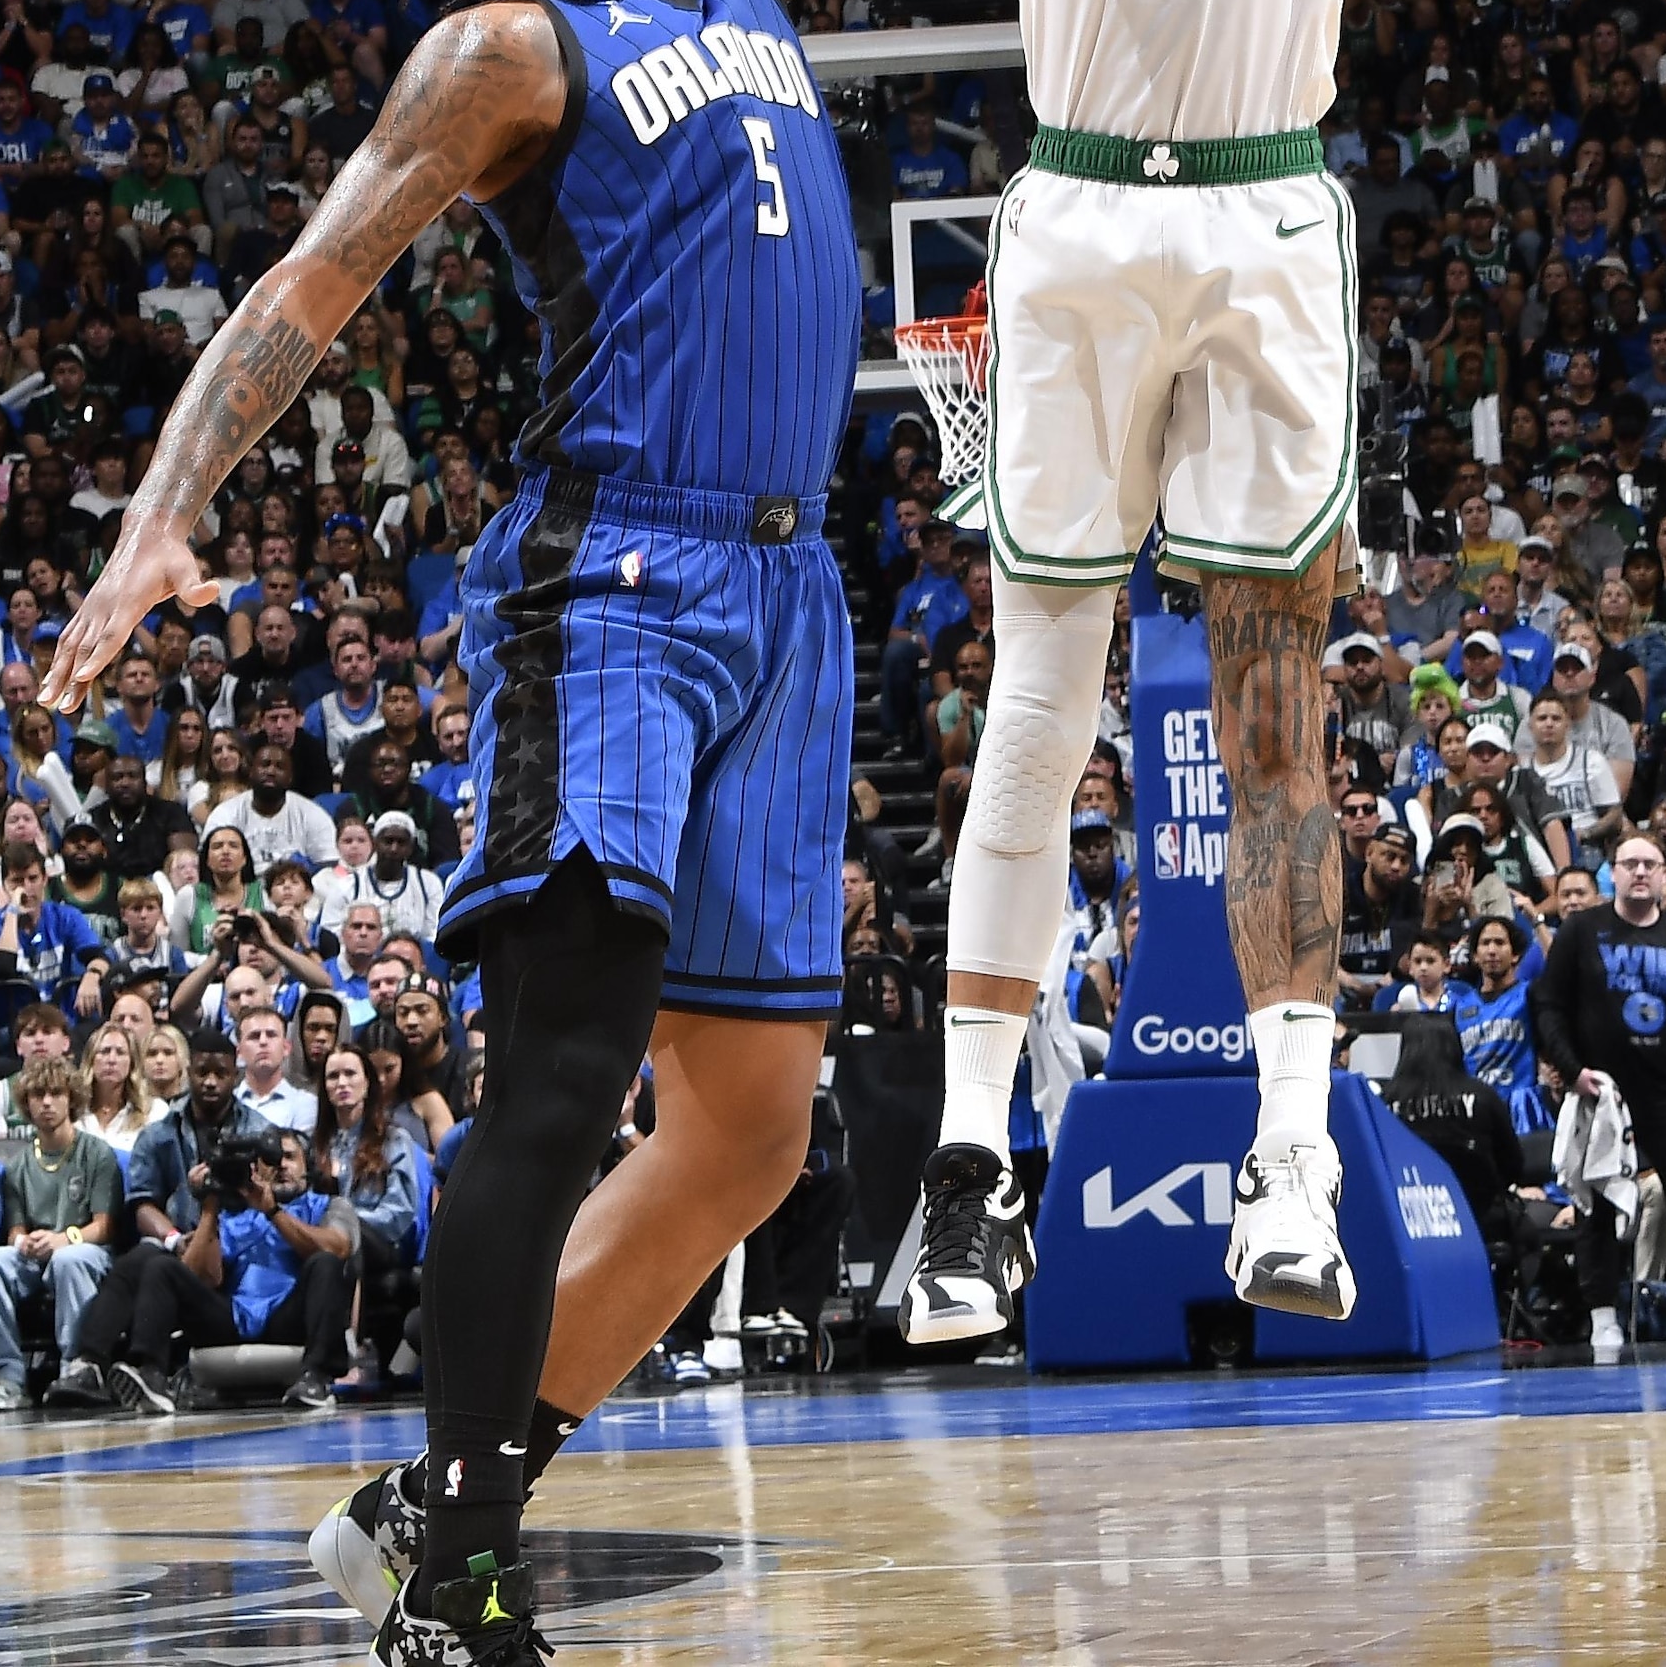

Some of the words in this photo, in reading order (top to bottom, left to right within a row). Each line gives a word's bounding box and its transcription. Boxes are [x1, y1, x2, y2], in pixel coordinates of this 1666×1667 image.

[610, 20, 821, 146] ORLANDO
[740, 118, 790, 236] 5
[1163, 709, 1220, 763] GET
[1165, 767, 1227, 818] THE
[1132, 1015, 1255, 1063] Googl
[1082, 1162, 1234, 1230] KI
